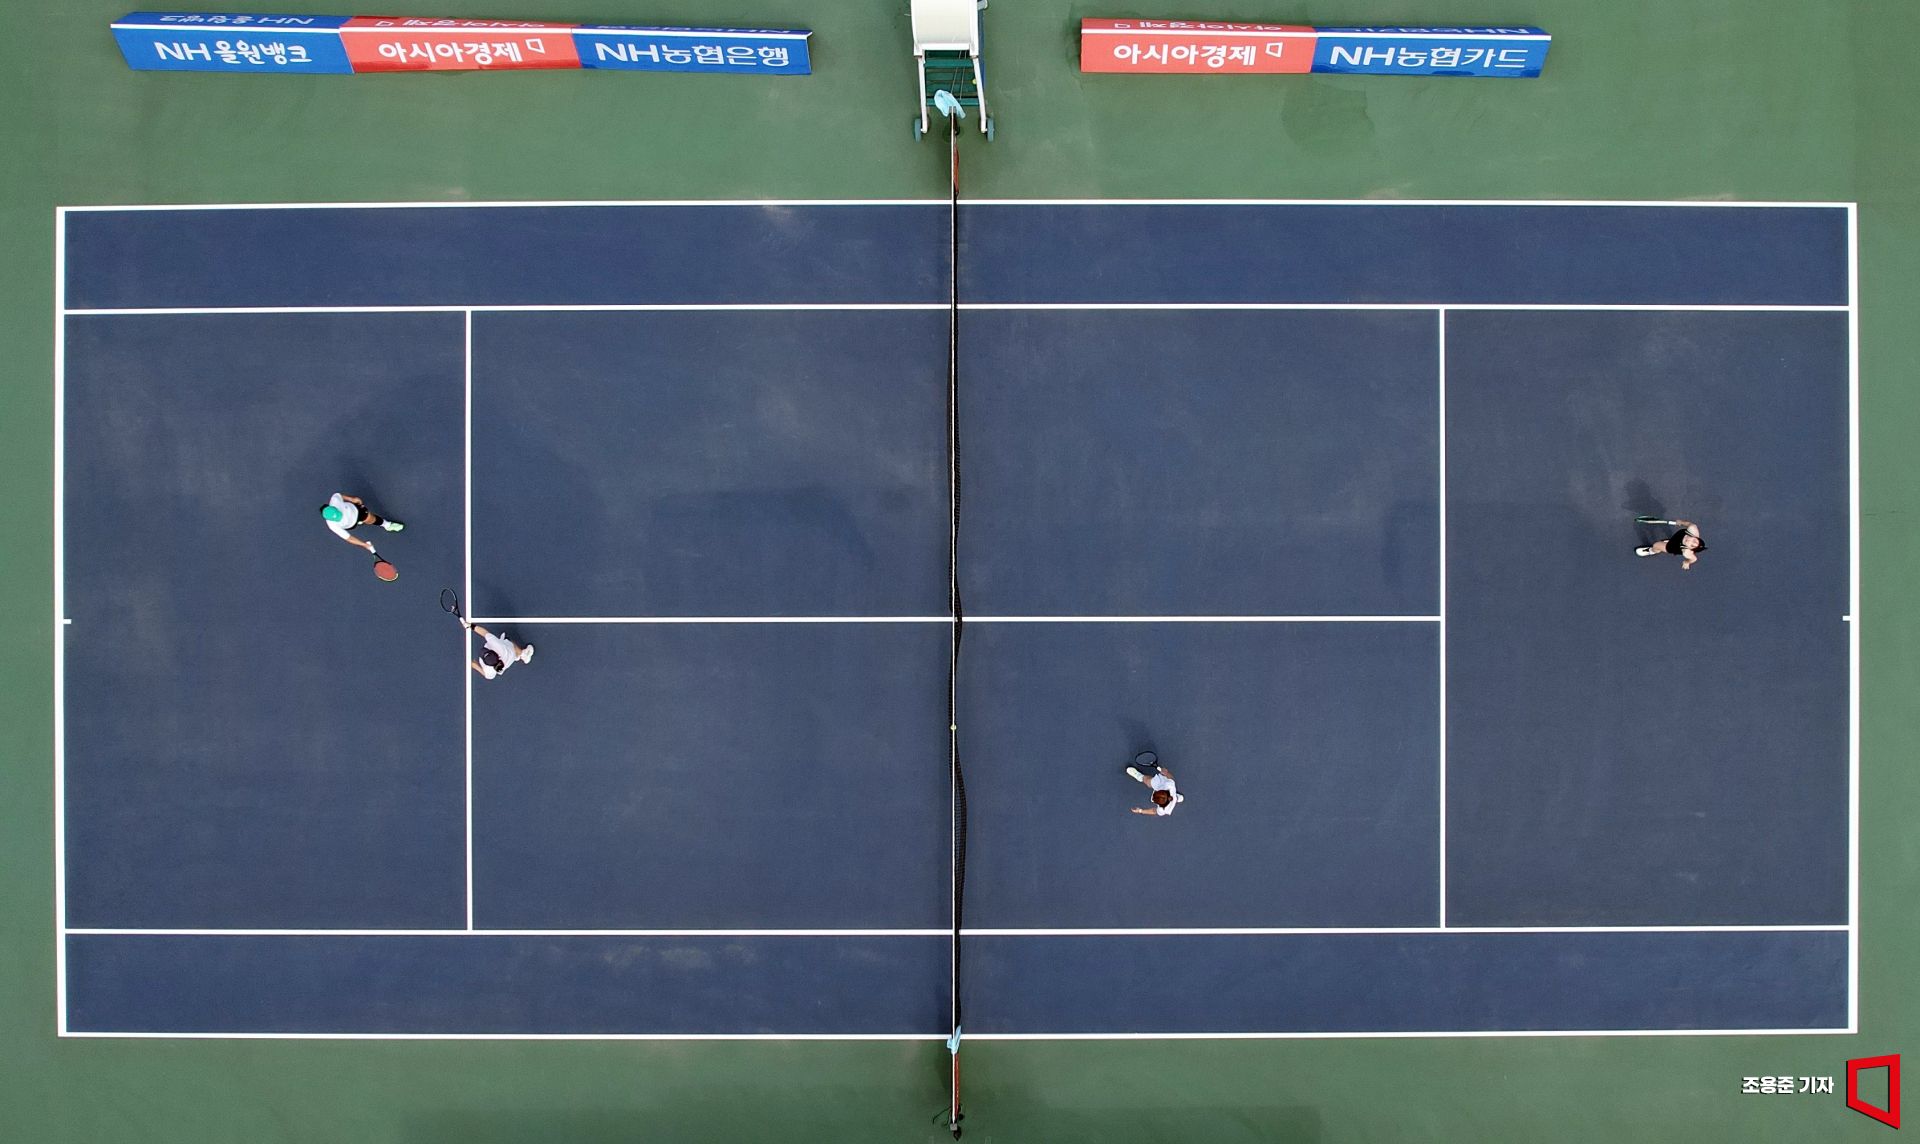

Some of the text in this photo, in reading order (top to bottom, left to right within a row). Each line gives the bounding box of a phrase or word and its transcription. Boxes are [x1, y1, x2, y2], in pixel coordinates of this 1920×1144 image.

[378, 41, 523, 64] 아시아경제
[595, 42, 789, 66] NH농협은행
[1113, 43, 1257, 66] 아시아경제
[1330, 46, 1528, 67] NH농협카드
